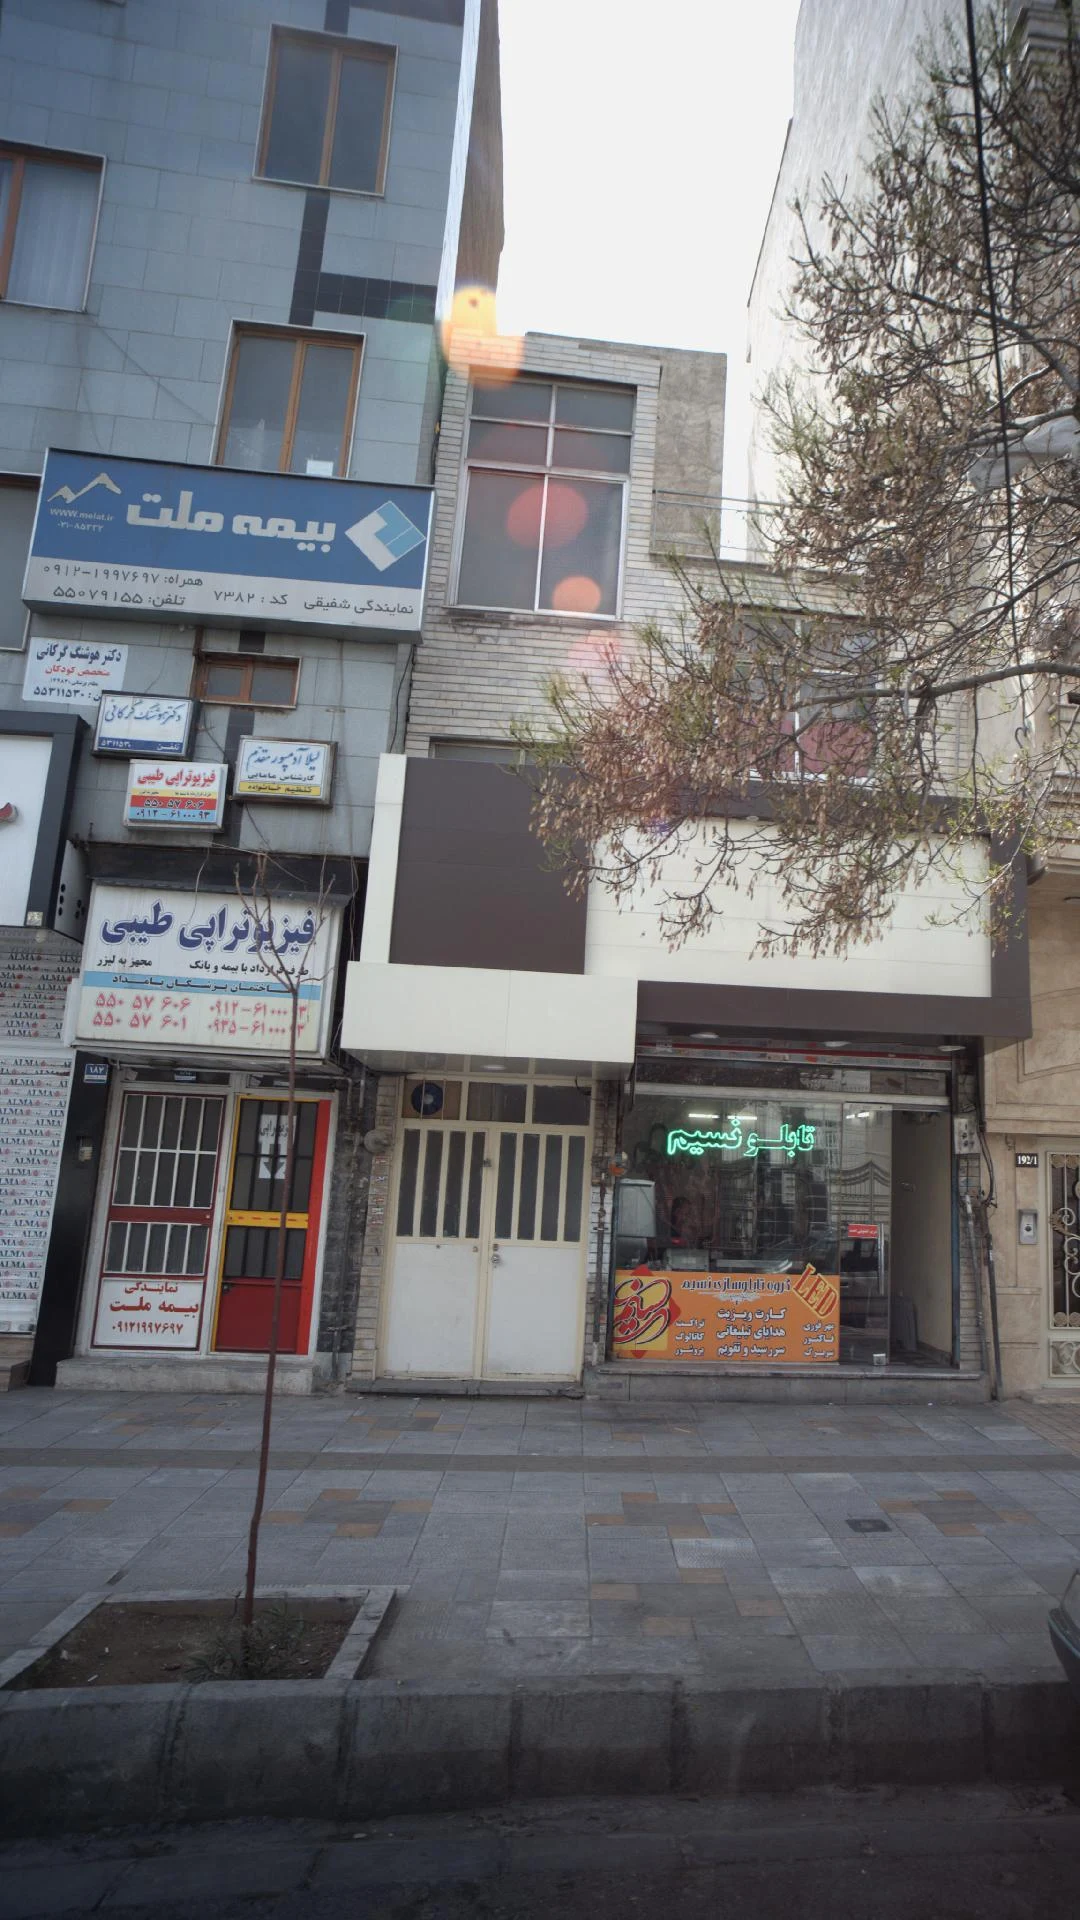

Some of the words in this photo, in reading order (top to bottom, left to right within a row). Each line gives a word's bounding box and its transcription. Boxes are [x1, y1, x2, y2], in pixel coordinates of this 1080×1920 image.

[126, 490, 224, 533] ملت
[232, 513, 337, 553] بیمه
[44, 564, 160, 584] ۰۹۱۲-۱۹۹۷۶۹۷
[53, 586, 143, 604] ۵۵۰۷۹۱۵۵
[213, 590, 255, 604] ۷۳۸۲
[304, 597, 350, 611] شفیقی
[354, 600, 414, 614] نمایندگی
[70, 646, 99, 665] هوشنگ
[102, 649, 122, 666] دکتر
[45, 664, 75, 675] کودکان
[78, 668, 111, 677] متخصص
[160, 703, 186, 725] دکتر
[165, 768, 217, 787] فیزیوتراپی
[178, 903, 317, 953] فیزیوتراپی
[118, 957, 127, 965] به
[130, 958, 153, 968] مجهز
[189, 959, 211, 973] بانک
[221, 963, 239, 974] بیمه
[212, 965, 218, 974] و
[230, 982, 293, 994] اختمان
[666, 1119, 742, 1155] نسیم
[743, 1123, 816, 1158] تابلو
[1017, 1155, 1038, 1165] 192/1
[124, 1281, 179, 1294] نمایندگی
[681, 1275, 712, 1291] نسیم
[767, 1277, 792, 1293] گروه
[793, 1263, 839, 1320] LED
[109, 1296, 152, 1312] ملت
[158, 1300, 199, 1319] بیمه
[716, 1308, 754, 1322] ویزیت
[754, 1307, 787, 1320] کارت
[112, 1320, 184, 1335] ۰۹۱۲۱۹۹۷۶۹۷
[675, 1318, 705, 1329] تراکت
[675, 1332, 705, 1343] کاتالوگ
[716, 1325, 752, 1340] تبلیغاتی
[753, 1325, 786, 1340] هدایای
[674, 1345, 705, 1357] بروشور
[718, 1342, 741, 1357] تقویم
